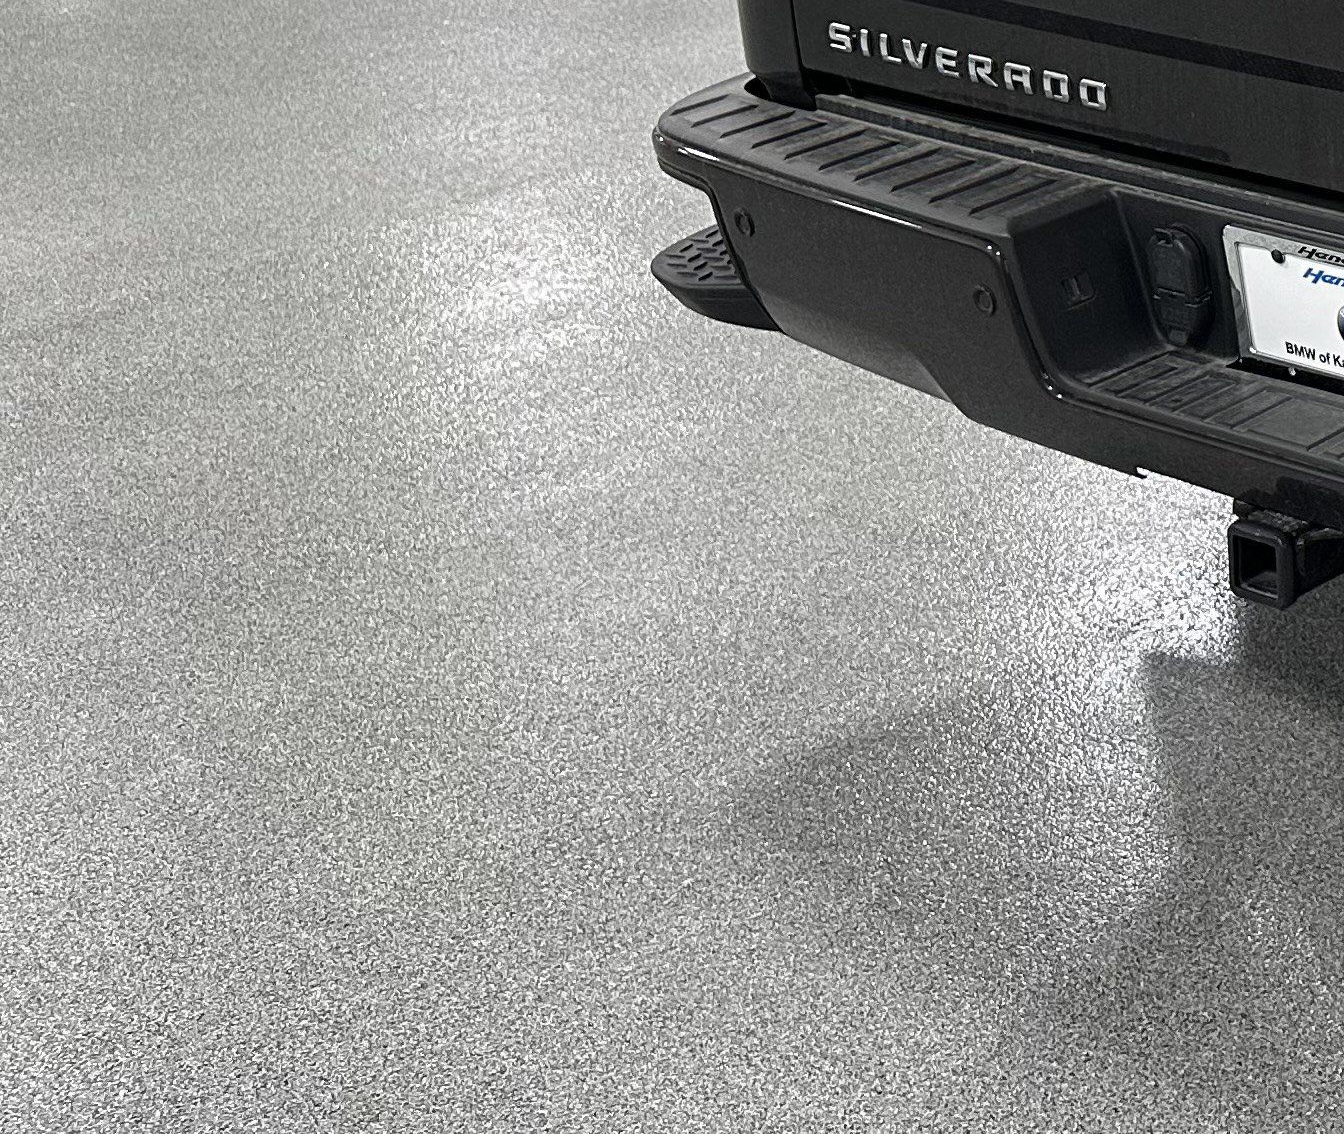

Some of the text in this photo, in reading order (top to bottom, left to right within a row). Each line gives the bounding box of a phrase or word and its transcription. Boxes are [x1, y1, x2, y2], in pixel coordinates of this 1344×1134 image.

[829, 22, 1107, 111] SILVERADO
[1285, 341, 1316, 361] BMW
[1319, 352, 1331, 365] of
